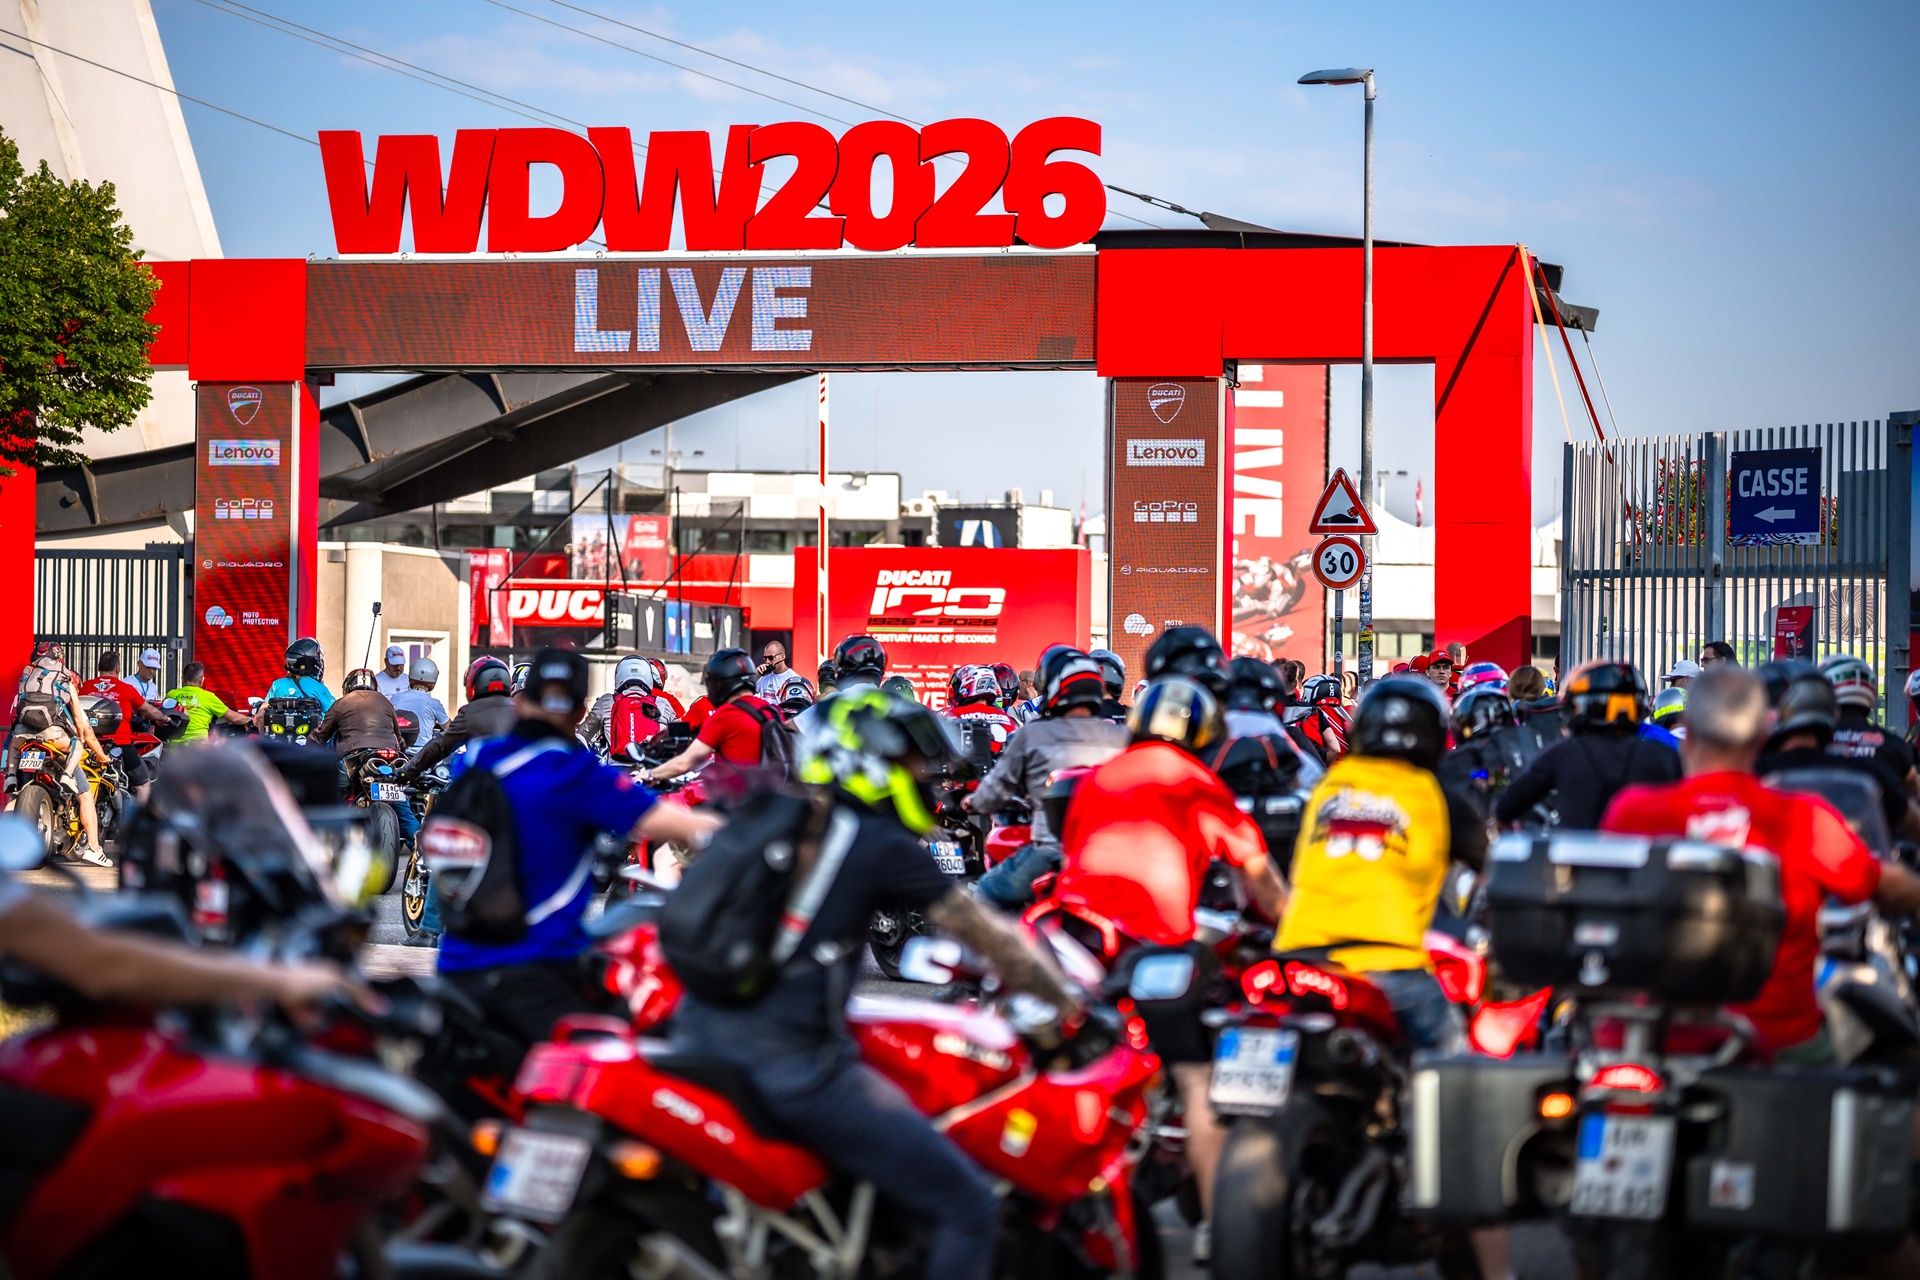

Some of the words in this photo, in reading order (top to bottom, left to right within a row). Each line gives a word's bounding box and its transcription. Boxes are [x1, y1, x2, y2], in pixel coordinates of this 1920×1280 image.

[318, 117, 1105, 253] WDW2026
[574, 266, 812, 351] LIVE
[214, 445, 274, 459] Lenovo
[1133, 445, 1198, 459] Lenovo
[1738, 467, 1808, 497] CASSE
[215, 498, 274, 509] GoPro
[1133, 500, 1198, 511] GoPro
[1324, 551, 1355, 575] 30
[876, 570, 952, 586] DUCATI
[867, 617, 916, 626] 1926
[938, 617, 999, 626] 2026
[174, 639, 183, 648] 10
[872, 634, 912, 643] CENTURY
[913, 634, 940, 643] MADE
[942, 634, 954, 643] OF
[955, 634, 997, 643] SECONDS
